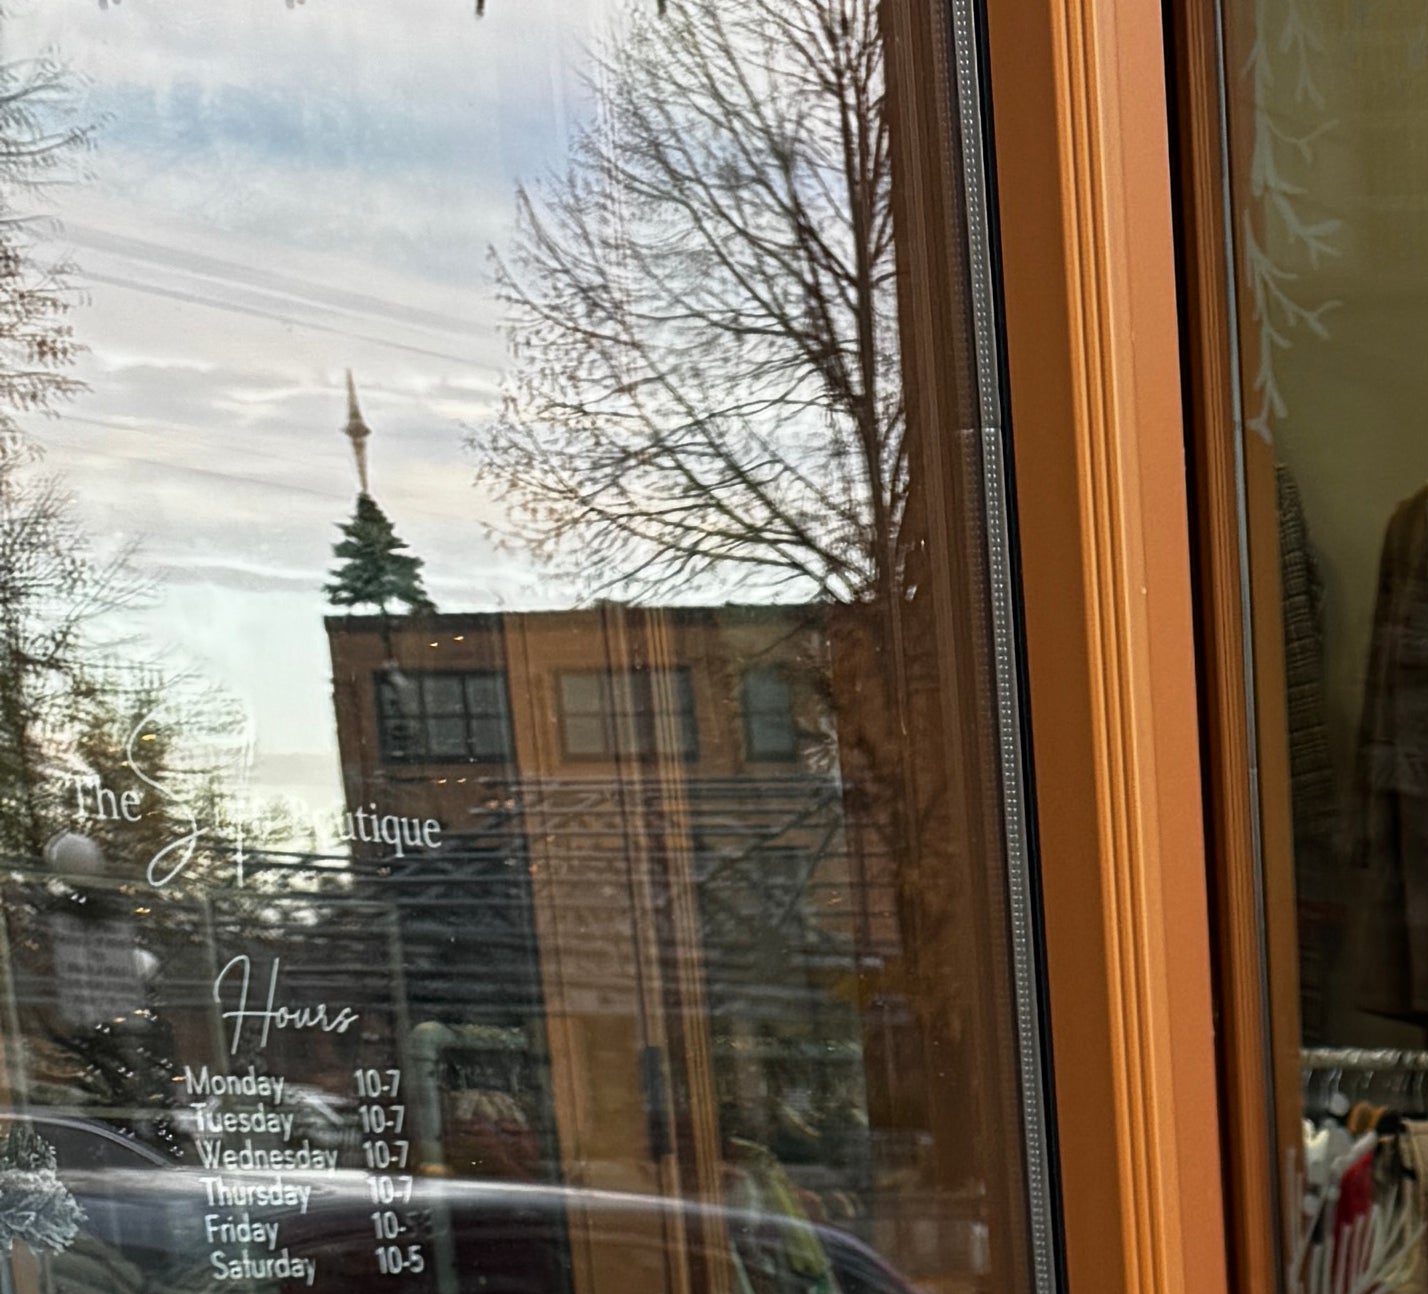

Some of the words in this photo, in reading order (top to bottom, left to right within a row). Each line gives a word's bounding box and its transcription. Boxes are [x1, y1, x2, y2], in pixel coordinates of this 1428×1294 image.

[68, 774, 142, 823] The
[213, 954, 361, 1056] Hours
[184, 1065, 284, 1104] Monday
[354, 1069, 400, 1097] 10-7
[190, 1103, 293, 1141] Tuesday
[359, 1105, 404, 1133] 10-7
[195, 1139, 338, 1178] Wednesday
[363, 1140, 409, 1168] 10-7
[199, 1175, 311, 1214] Thursday
[367, 1176, 412, 1204] 10-7
[204, 1213, 279, 1250] Friday
[210, 1248, 316, 1286] Saturday
[375, 1245, 424, 1274] 10-5
